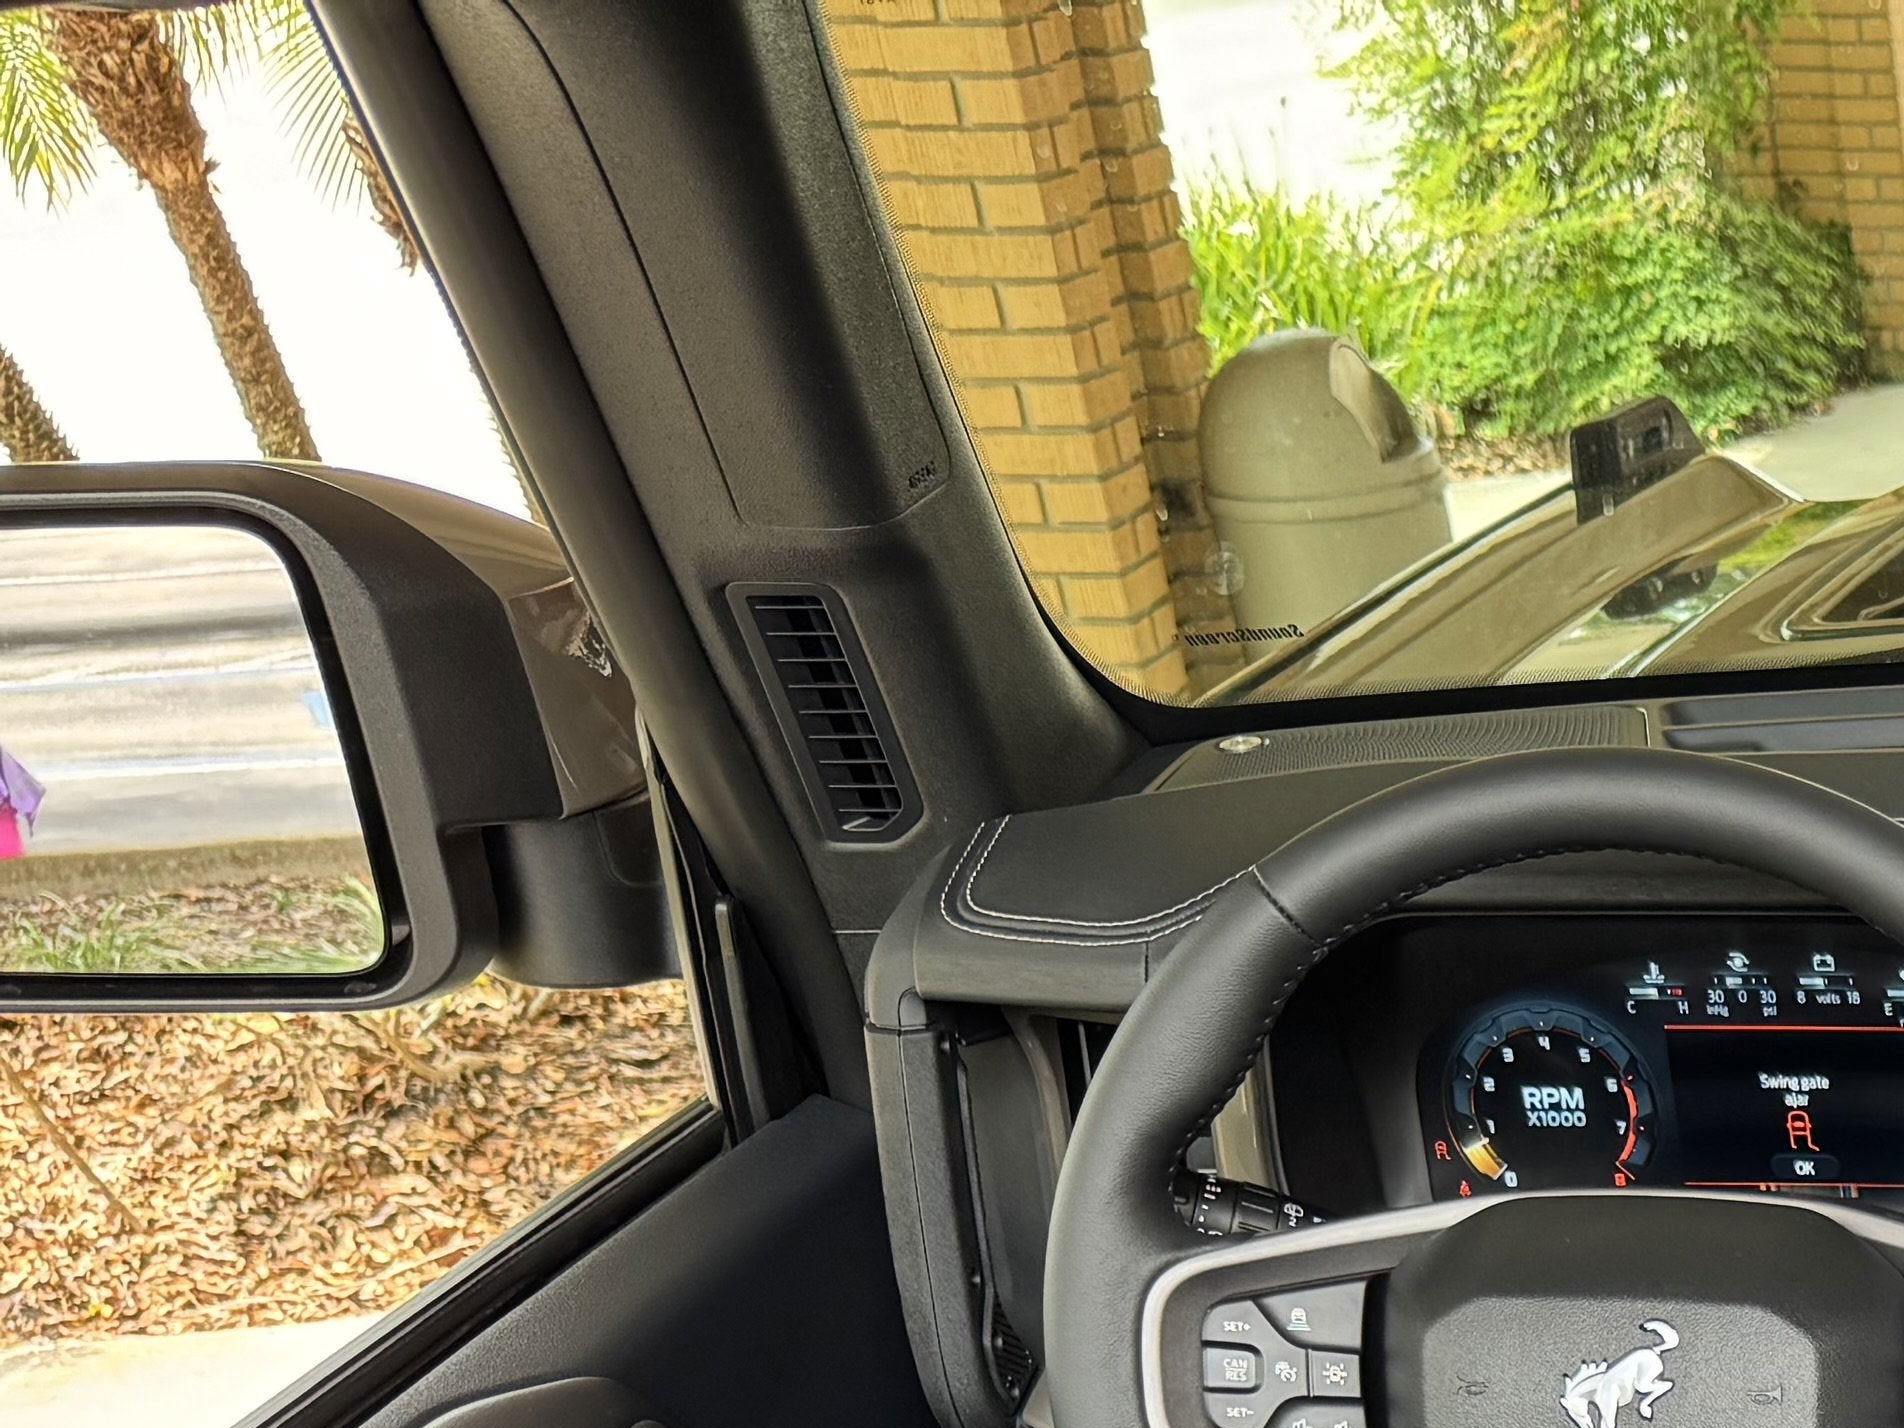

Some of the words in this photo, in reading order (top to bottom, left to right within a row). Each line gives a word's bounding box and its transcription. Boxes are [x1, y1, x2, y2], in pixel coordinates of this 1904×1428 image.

[1707, 989, 1725, 1004] 30
[1738, 989, 1748, 1004] 0
[1760, 989, 1777, 1004] 30
[1796, 990, 1806, 1004] 8
[1846, 990, 1861, 1005] 18
[1627, 1001, 1637, 1014] C
[1678, 1001, 1690, 1015] H
[1884, 1003, 1893, 1016] E
[1538, 1036, 1550, 1051] 4
[1502, 1048, 1514, 1062] 3
[1578, 1048, 1591, 1062] 5
[1482, 1076, 1495, 1092] 2
[1606, 1077, 1618, 1092] 6
[1758, 1073, 1799, 1091] Swing
[1800, 1075, 1830, 1092] gate
[1521, 1085, 1585, 1110] RPM
[1784, 1093, 1810, 1108] ajar
[1526, 1110, 1587, 1127] X1000
[1486, 1120, 1495, 1134] 1
[1616, 1120, 1627, 1135] 7
[1794, 1160, 1816, 1176] OK
[1504, 1170, 1518, 1187] 0
[1225, 1370, 1247, 1382] RES
